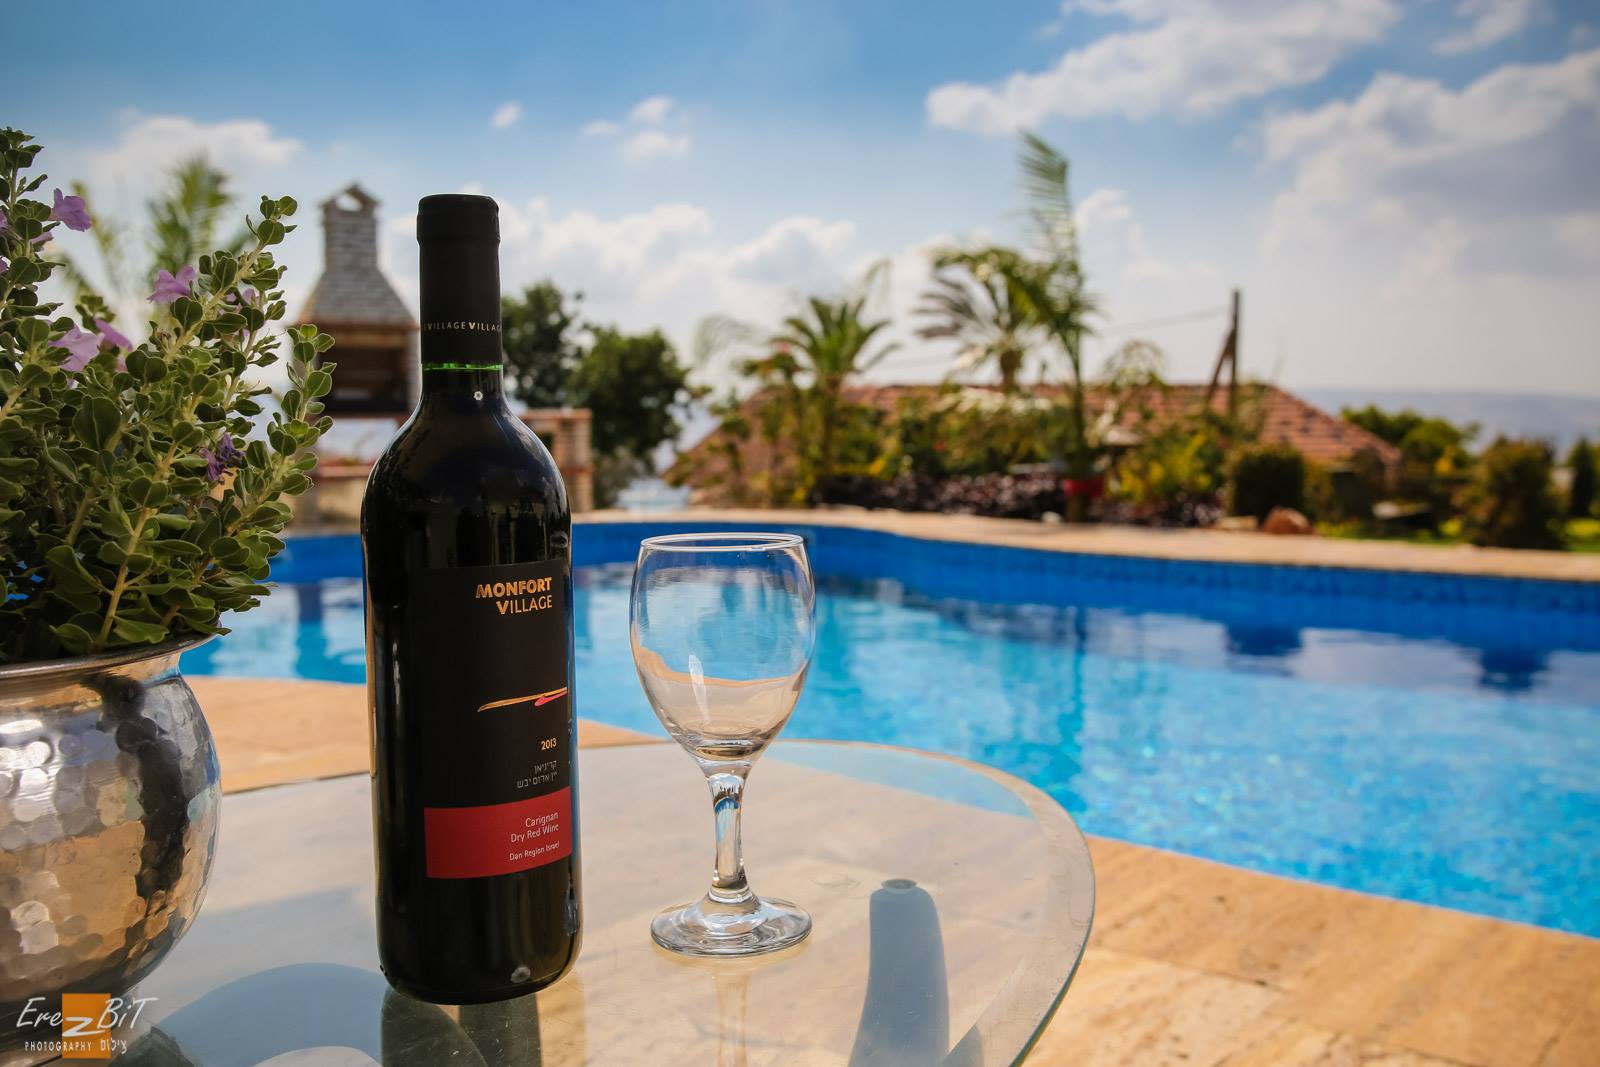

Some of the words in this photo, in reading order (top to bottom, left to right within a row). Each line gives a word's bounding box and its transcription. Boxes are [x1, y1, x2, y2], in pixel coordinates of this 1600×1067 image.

[475, 577, 552, 598] MONFORT
[496, 595, 553, 615] VILLAGE
[541, 737, 557, 750] 2013
[525, 812, 559, 828] Carignan
[511, 833, 525, 843] Dry
[527, 828, 541, 839] Red
[542, 823, 559, 835] Wine
[509, 853, 523, 861] Dan
[524, 847, 545, 857] Region
[546, 840, 560, 852] Israel
